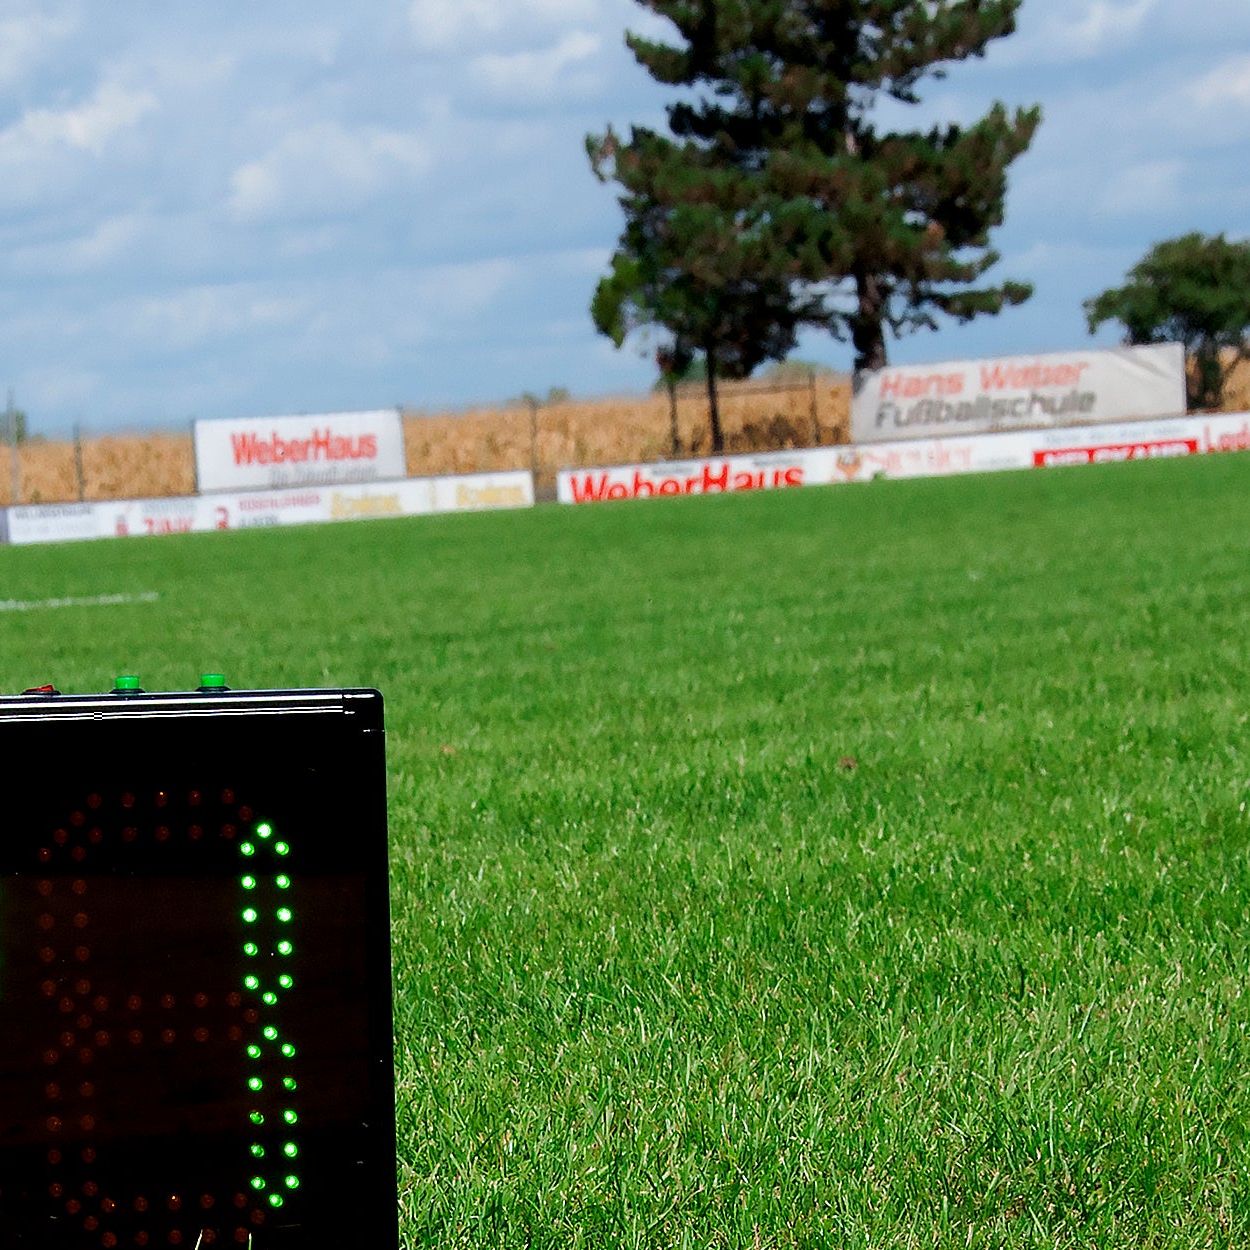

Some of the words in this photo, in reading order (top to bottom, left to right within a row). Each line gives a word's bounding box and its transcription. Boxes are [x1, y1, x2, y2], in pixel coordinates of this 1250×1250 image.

[878, 371, 965, 399] Hans
[231, 426, 378, 466] WeberHaus
[570, 459, 805, 504] WeberHaus
